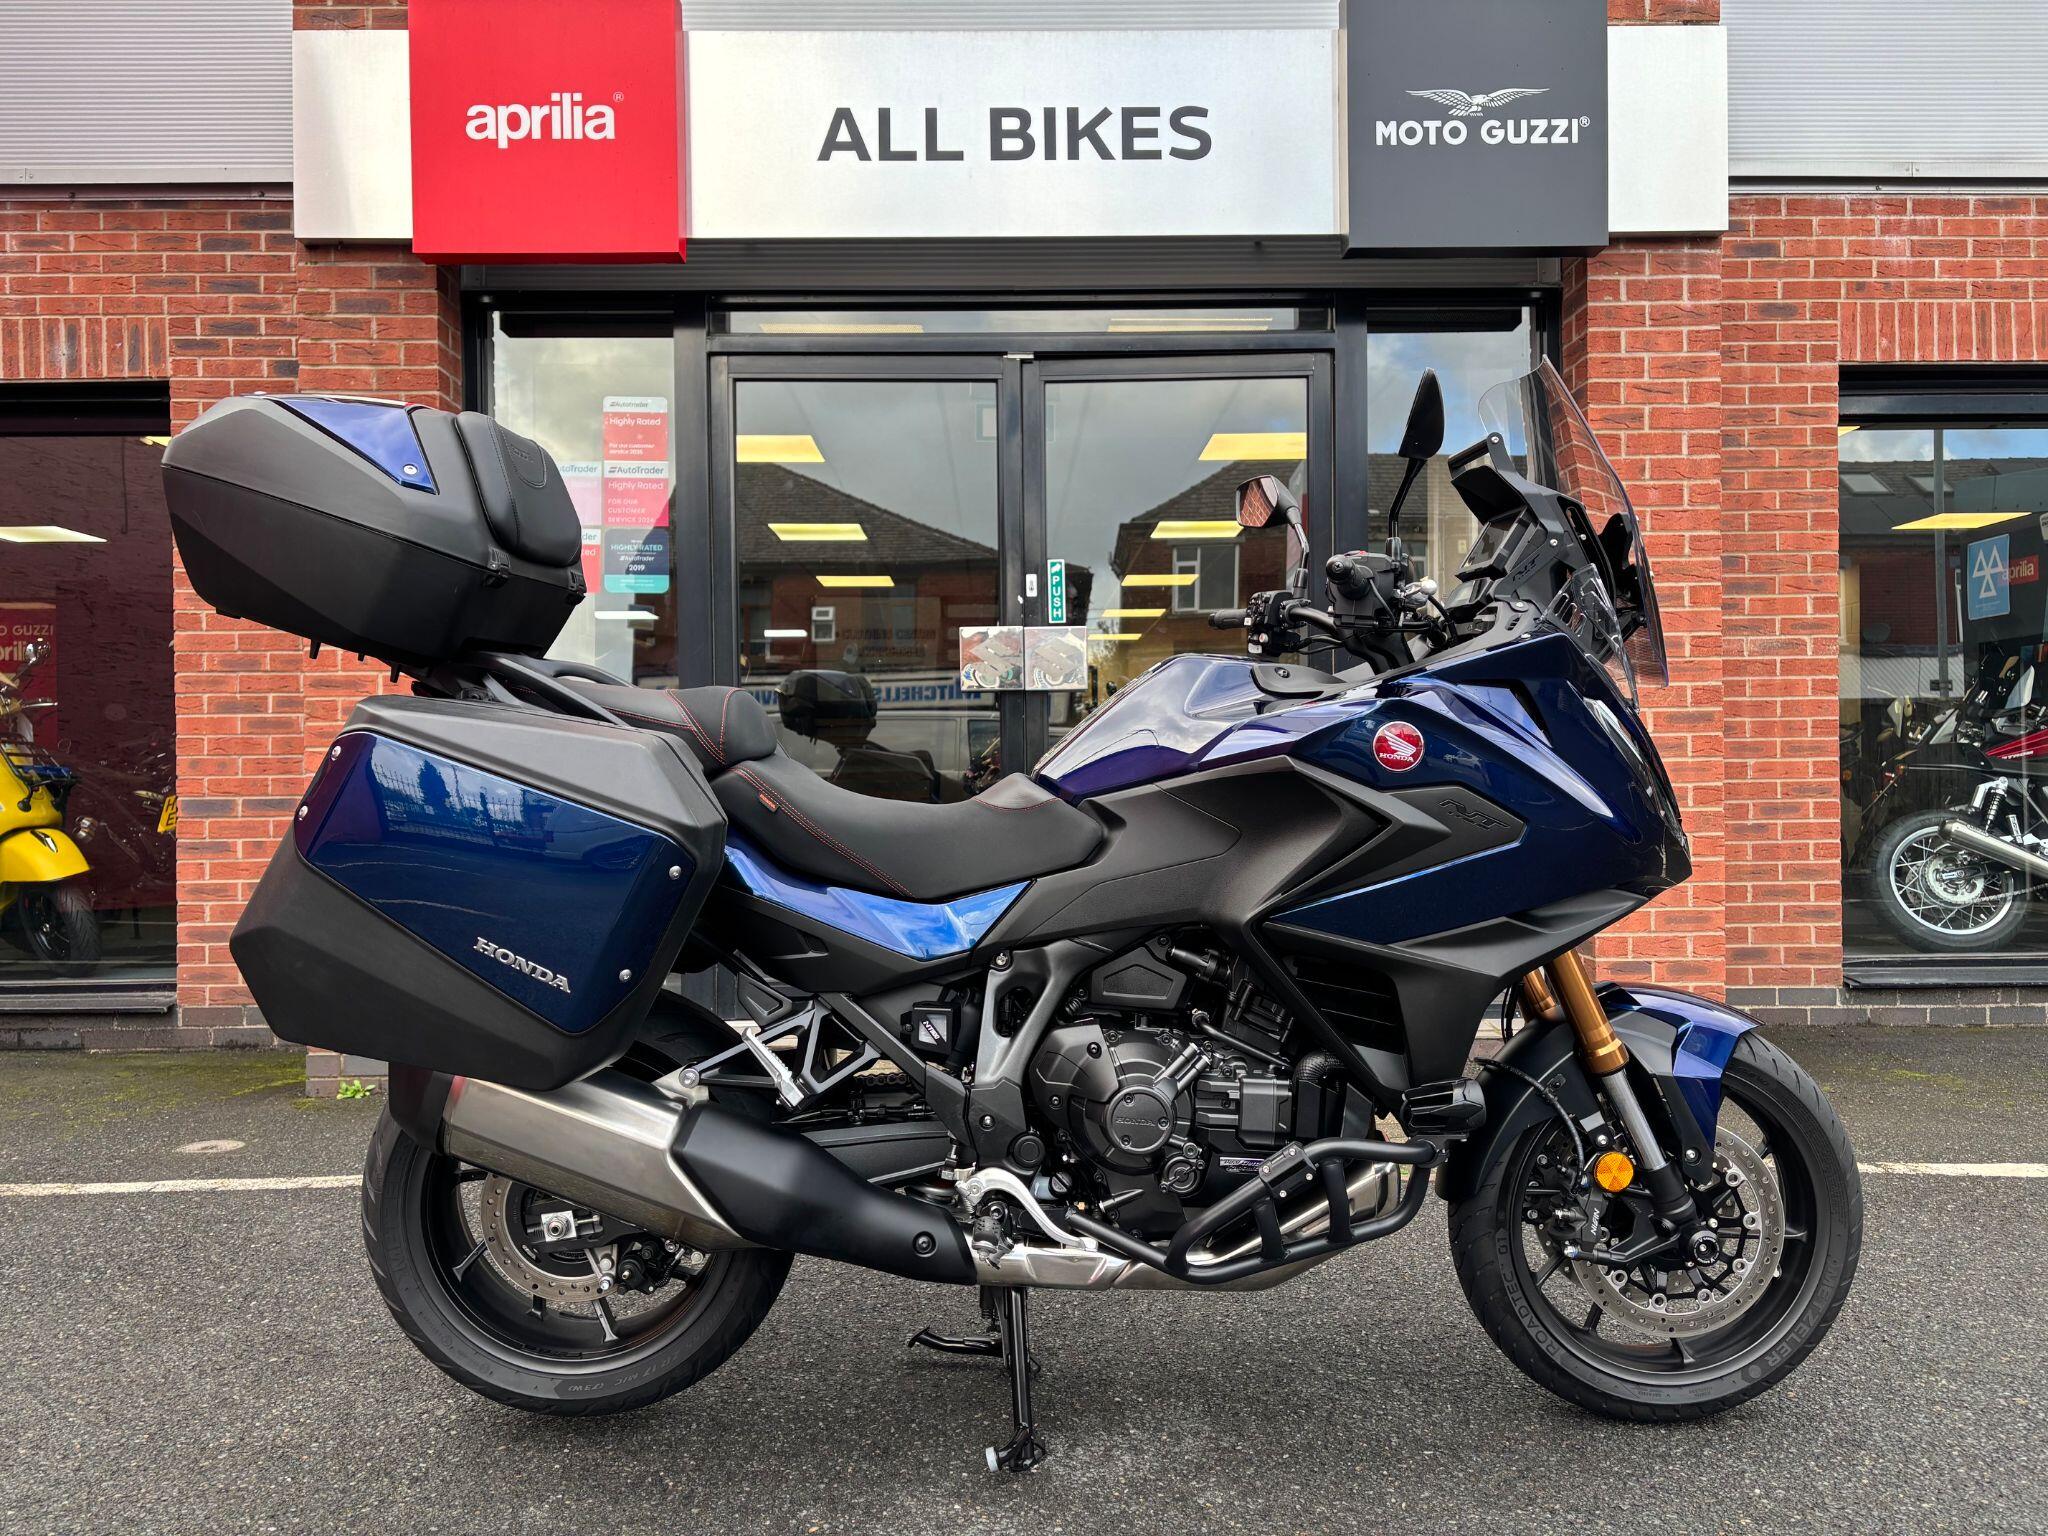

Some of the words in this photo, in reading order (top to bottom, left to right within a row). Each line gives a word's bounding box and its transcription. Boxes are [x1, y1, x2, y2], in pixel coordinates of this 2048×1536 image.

[817, 107, 964, 161] ALL
[989, 105, 1212, 161] BIKES
[1375, 120, 1468, 145] MOTO
[609, 417, 635, 427] Highly
[637, 417, 661, 425] Rated
[617, 466, 664, 475] AutoTrader
[608, 482, 635, 491] Highly
[637, 482, 664, 490] Rated
[610, 544, 639, 552] HIGHLY
[1052, 575, 1062, 618] PUSH
[12, 624, 54, 636] GUZZI
[1379, 752, 1415, 763] HONDA
[472, 936, 571, 994] HONDA
[1503, 1270, 1561, 1356] ROADTEC
